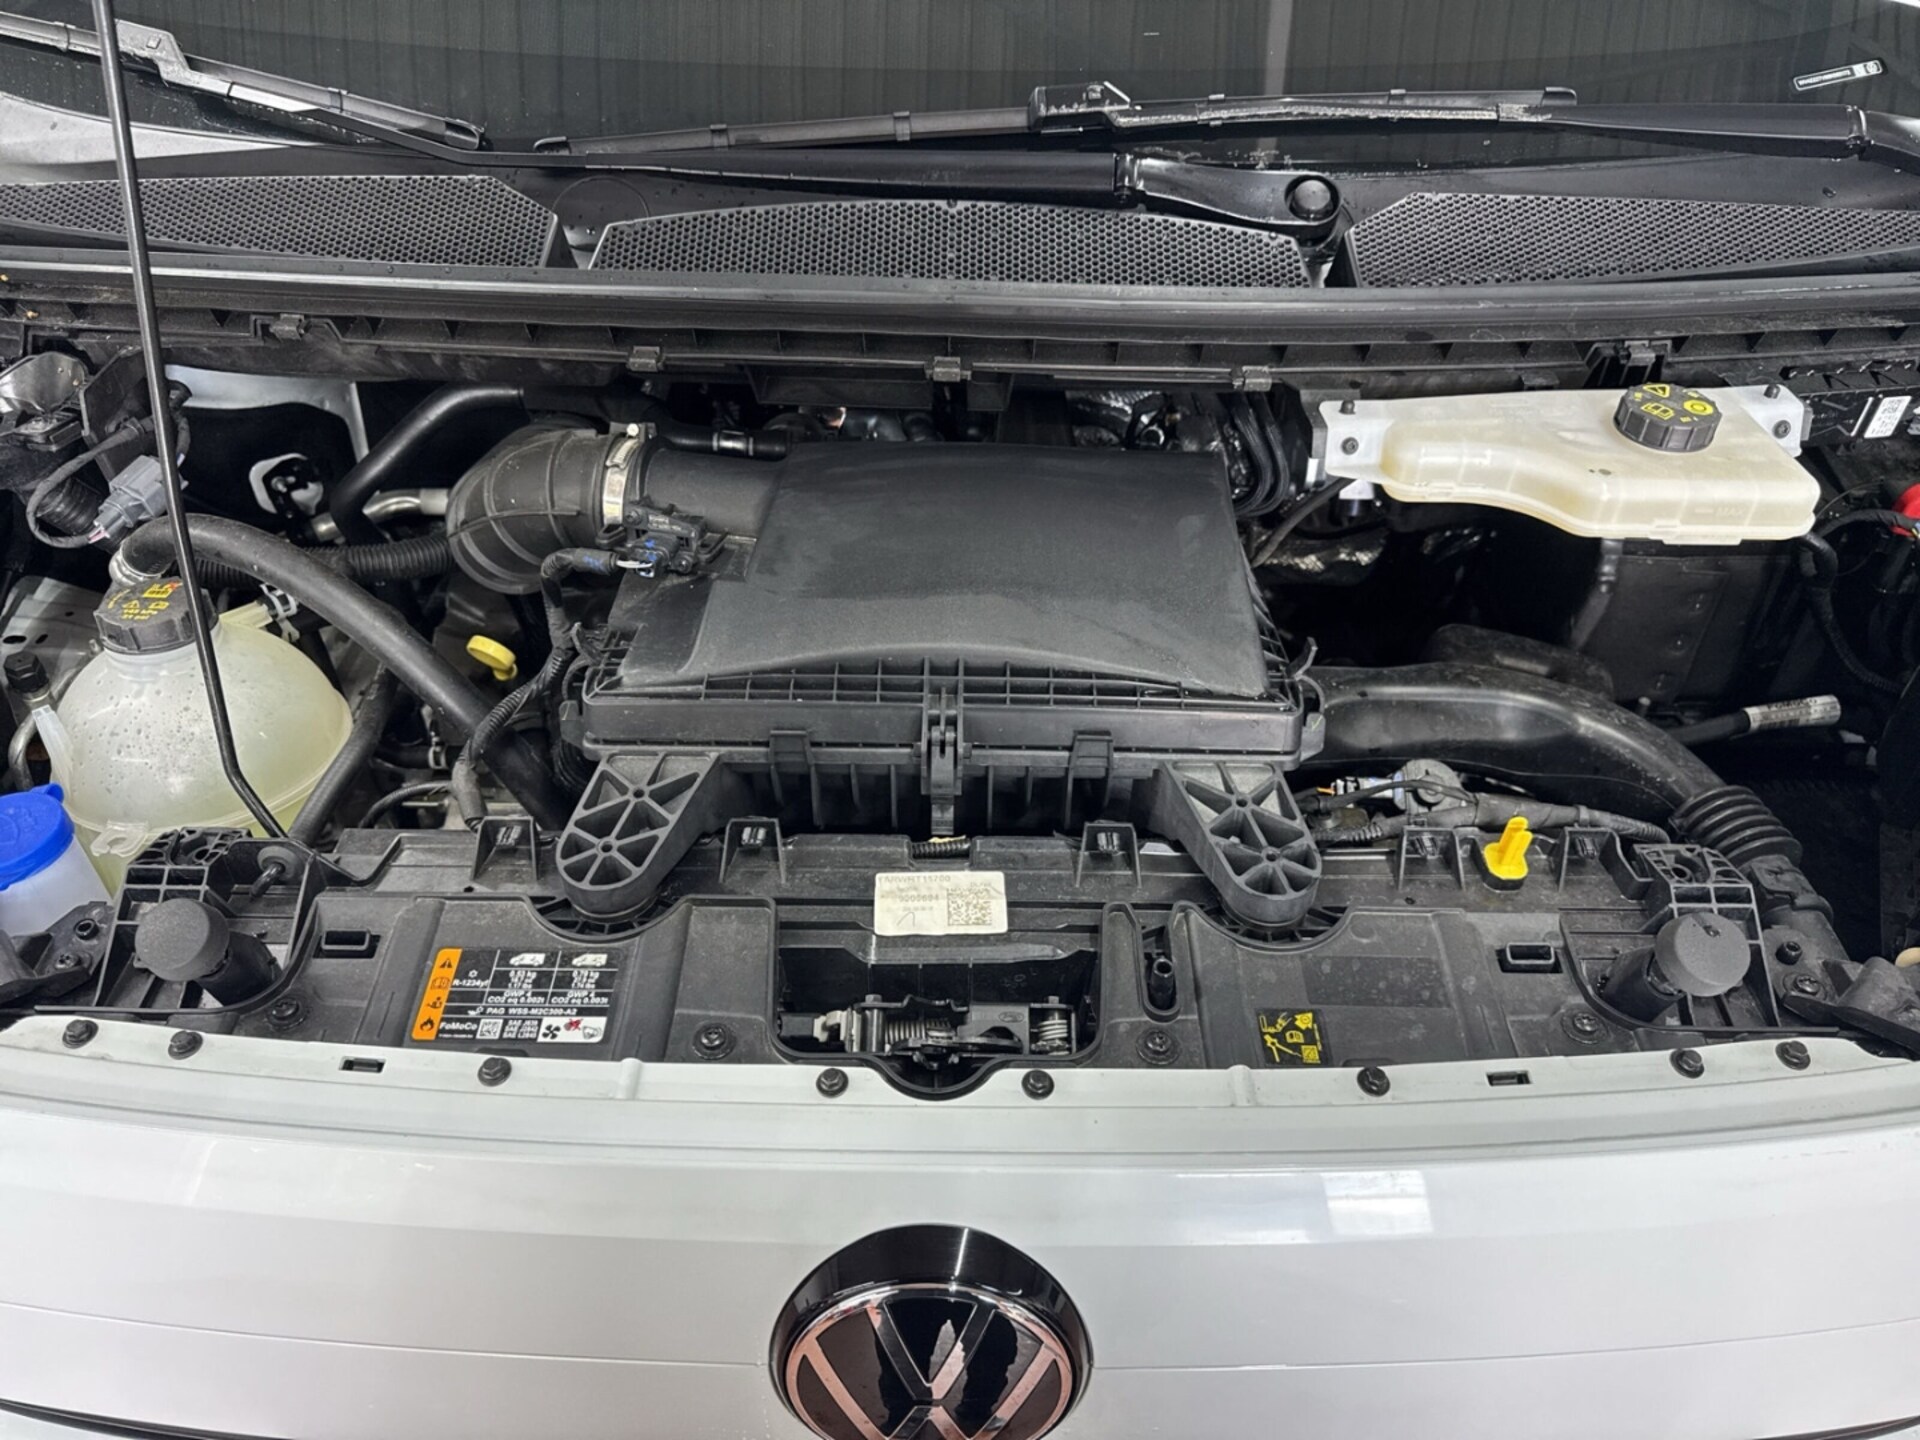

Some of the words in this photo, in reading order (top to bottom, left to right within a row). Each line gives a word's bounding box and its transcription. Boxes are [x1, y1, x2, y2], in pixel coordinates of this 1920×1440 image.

[453, 979, 489, 988] R-1234yf
[567, 990, 589, 998] GWP
[486, 1007, 505, 1015] PAG
[439, 1022, 477, 1030] FoMoCo
